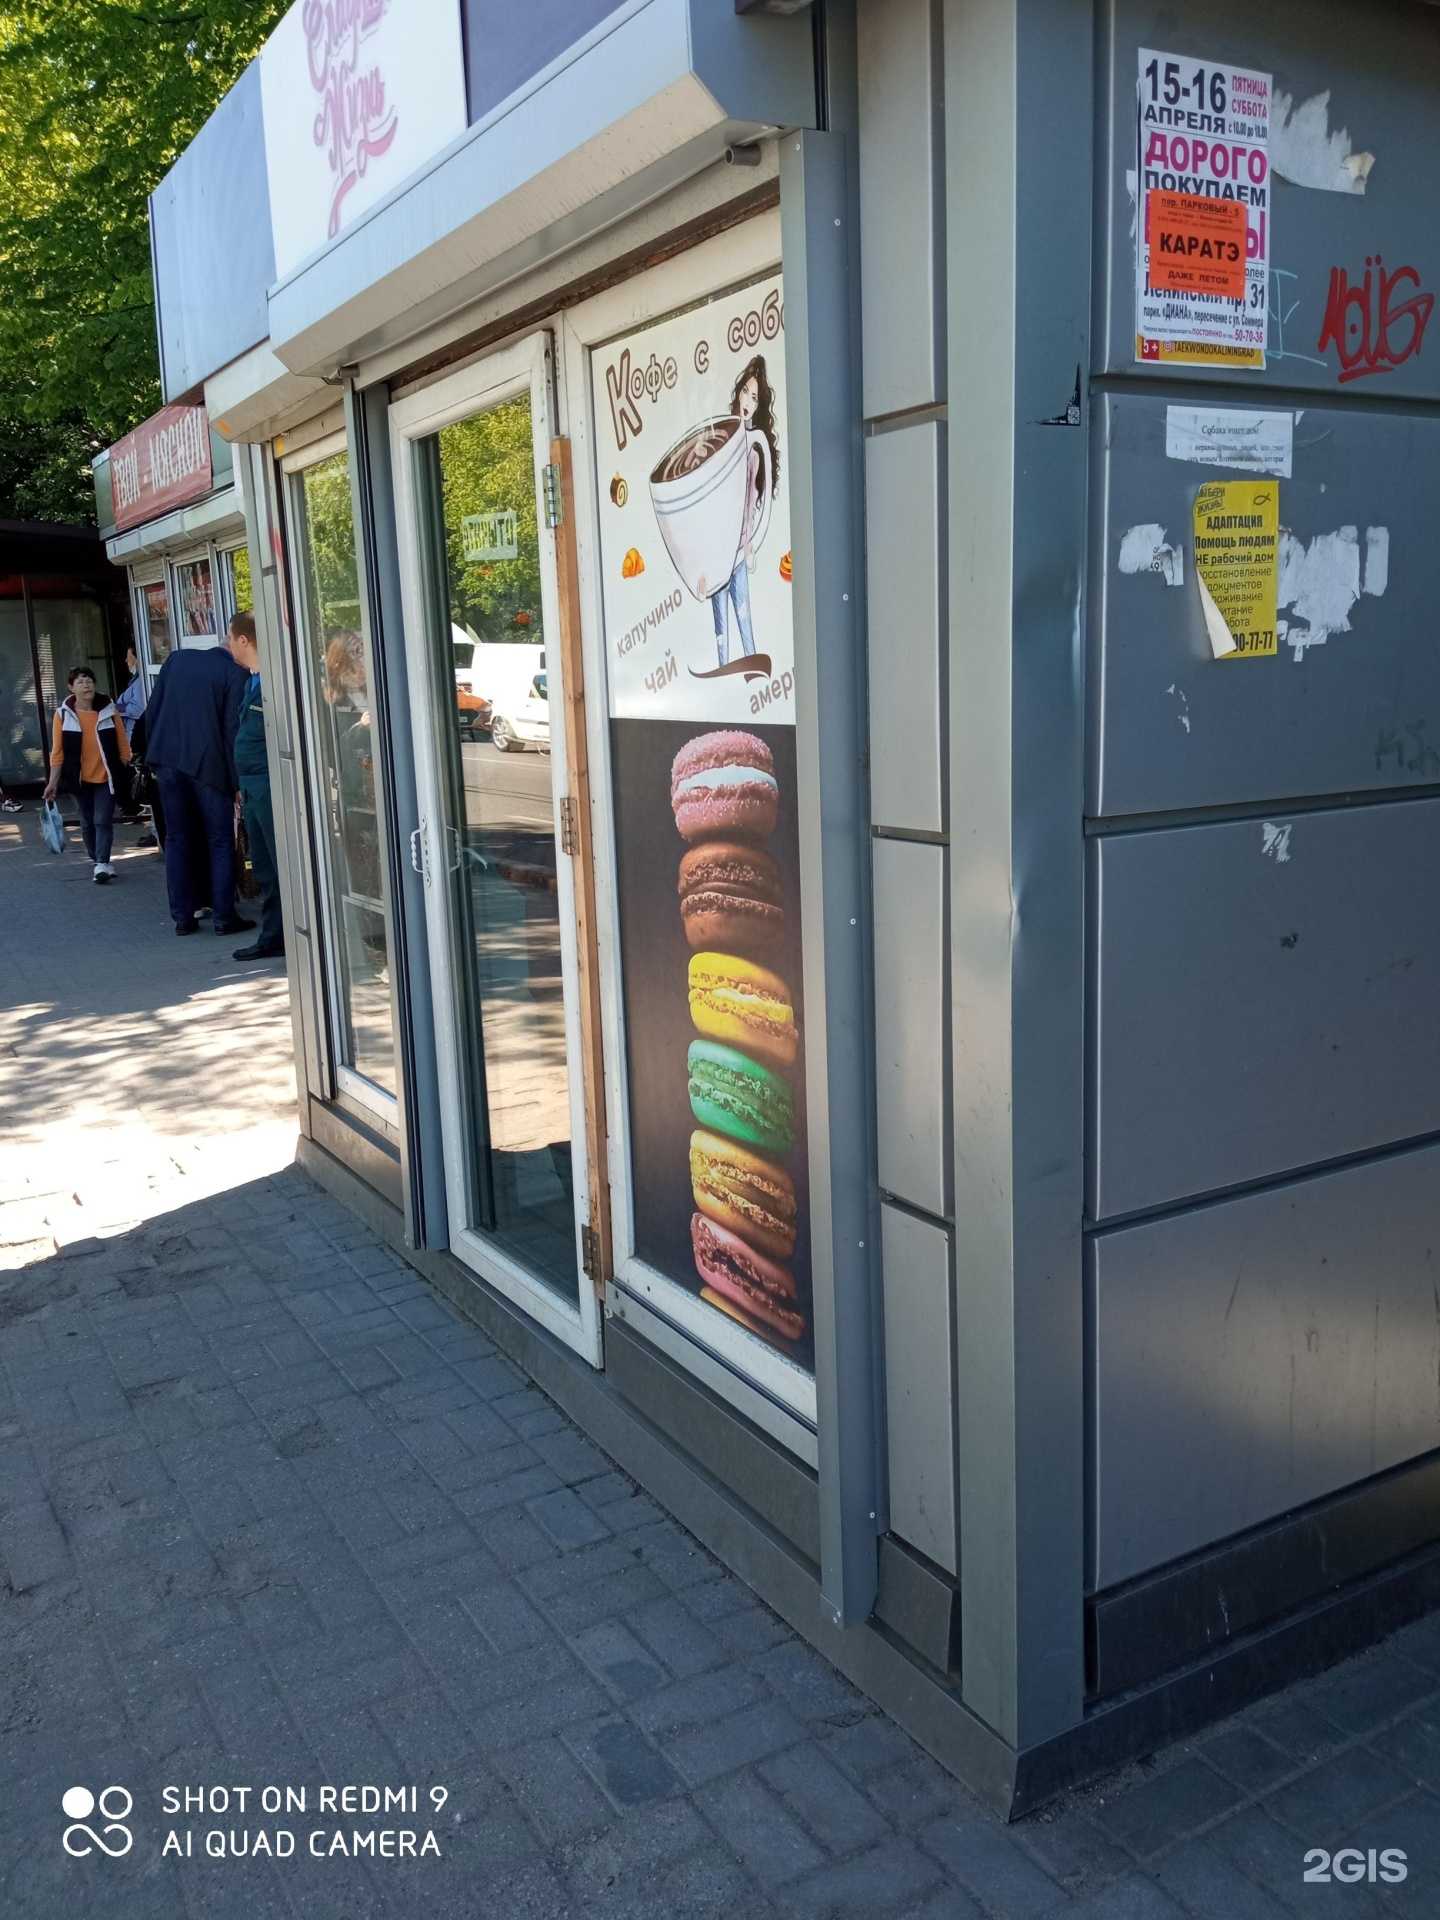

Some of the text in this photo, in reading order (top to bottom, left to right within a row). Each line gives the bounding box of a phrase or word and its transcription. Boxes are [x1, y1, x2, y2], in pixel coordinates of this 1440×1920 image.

[1146, 59, 1226, 113] 15-16
[1232, 75, 1267, 97] ПЯТНИЦА
[1232, 99, 1267, 118] СУББОТА
[1144, 104, 1226, 134] АПРЕЛЯ
[1145, 131, 1267, 184] ДОРОГО
[1145, 171, 1266, 207] ПОКУПАЕМ
[1160, 232, 1240, 261] КАРАТЭ
[1168, 270, 1229, 285] ДАЖЕ ЛЕТОМ
[1246, 267, 1264, 279] олее
[1250, 283, 1265, 310] 31
[606, 288, 784, 451] Кофе с соб
[1206, 515, 1263, 530] АДАПТАЦИЯ
[1195, 535, 1275, 549] Помощь людям
[1195, 552, 1274, 566] НЕ рабочий дом
[1200, 567, 1272, 580] осстановление
[1207, 581, 1262, 593] документов
[1212, 592, 1263, 603] оживание
[1220, 606, 1254, 616] итание
[617, 588, 682, 658] капучино
[1226, 617, 1250, 628] бота
[644, 648, 678, 693] чай
[750, 667, 795, 714] амер
